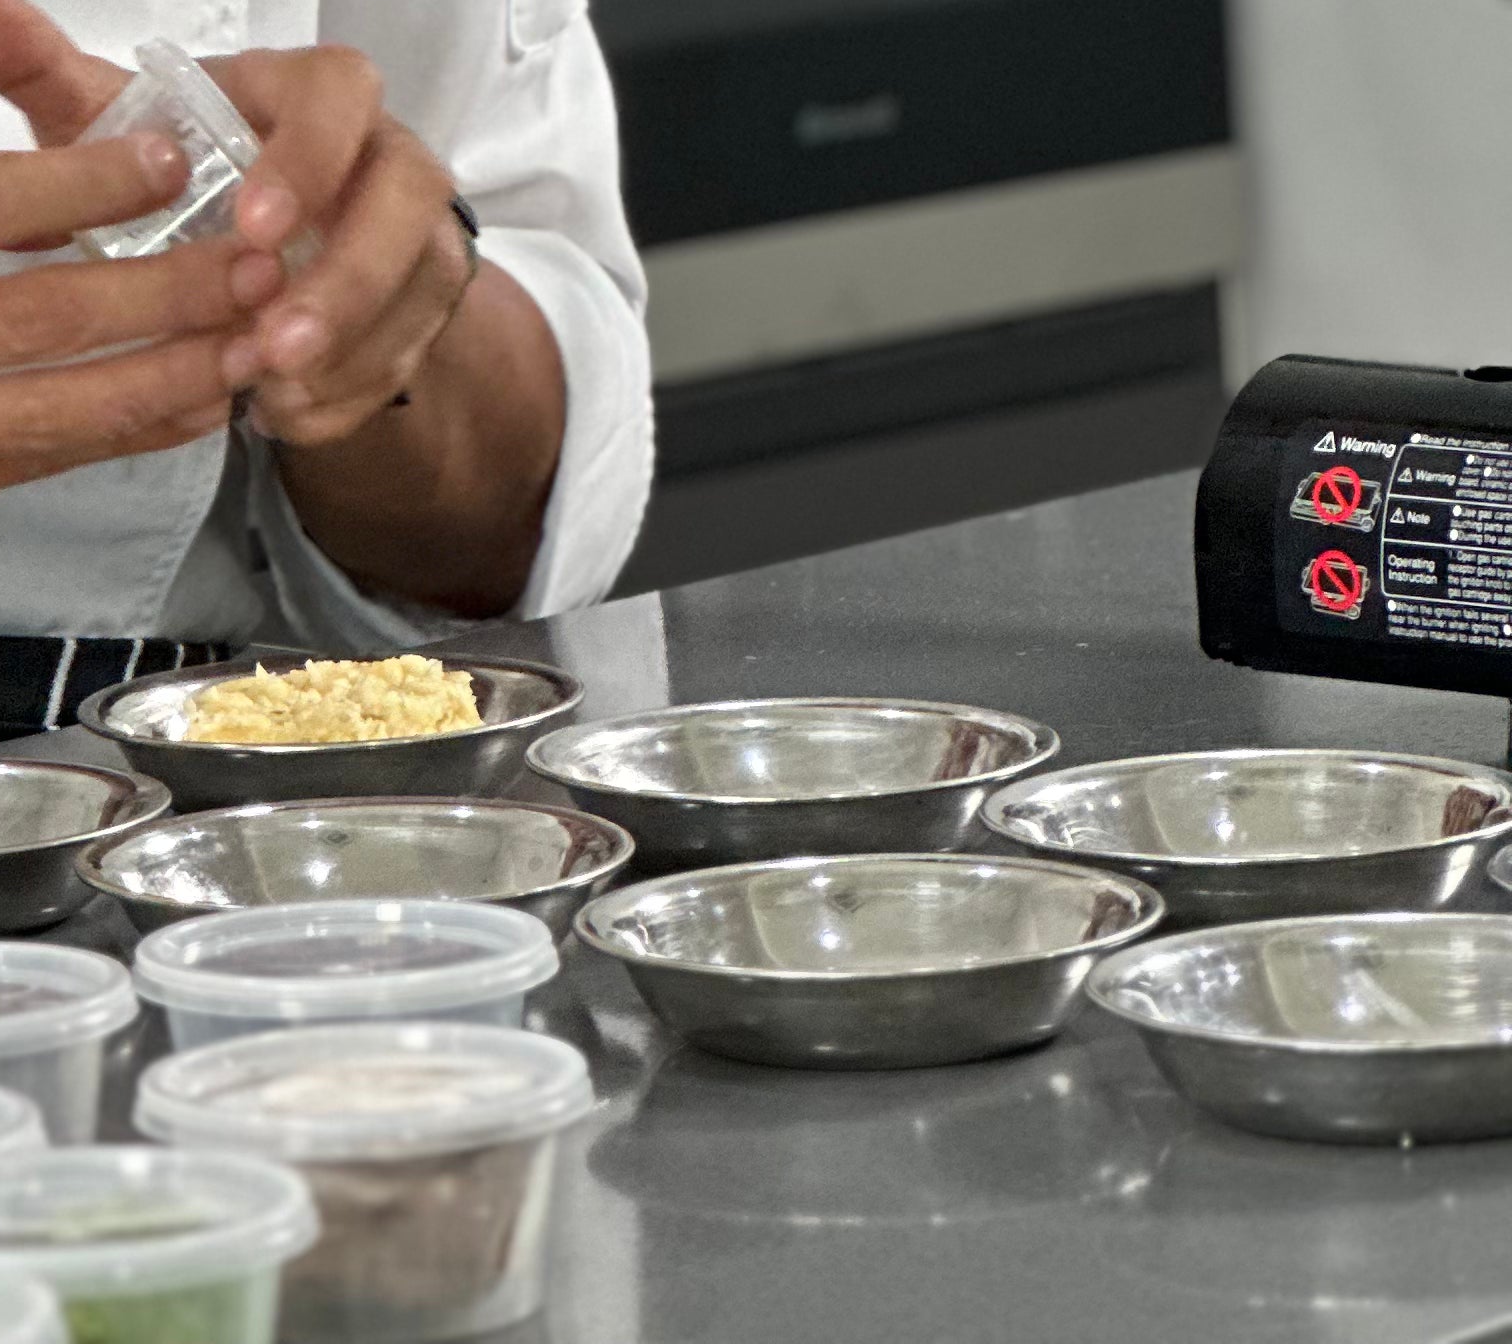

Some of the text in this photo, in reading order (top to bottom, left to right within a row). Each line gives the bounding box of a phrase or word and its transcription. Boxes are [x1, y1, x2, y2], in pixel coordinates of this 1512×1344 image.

[1341, 436, 1397, 459] Warning
[1415, 468, 1457, 486] Warning
[1407, 510, 1431, 525] Note
[1387, 554, 1436, 573] Operating
[1388, 569, 1438, 585] Instruction
